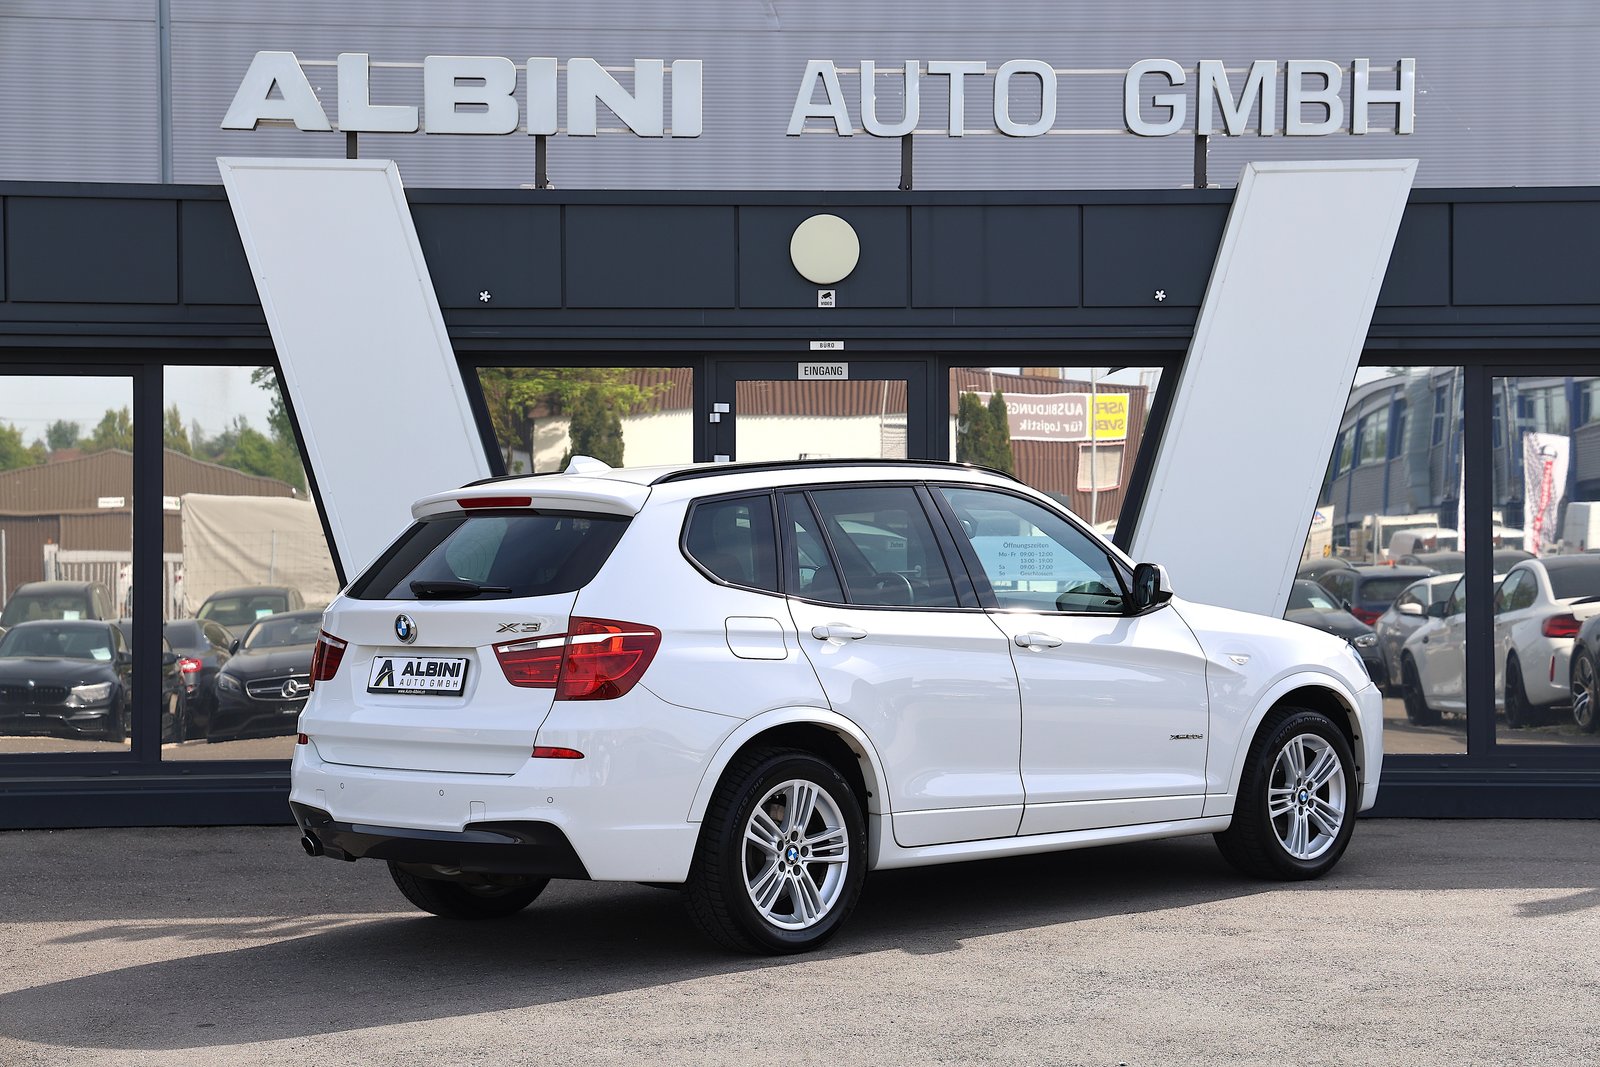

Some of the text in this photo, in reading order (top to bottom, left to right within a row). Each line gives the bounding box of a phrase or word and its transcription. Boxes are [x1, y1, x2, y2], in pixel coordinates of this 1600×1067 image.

[220, 50, 1416, 138] ALBINI AUTO GMBH
[804, 366, 843, 376] EINGANG
[496, 622, 541, 633] X3
[402, 661, 462, 678] ALBINI
[399, 678, 459, 688] AUTO GMBH
